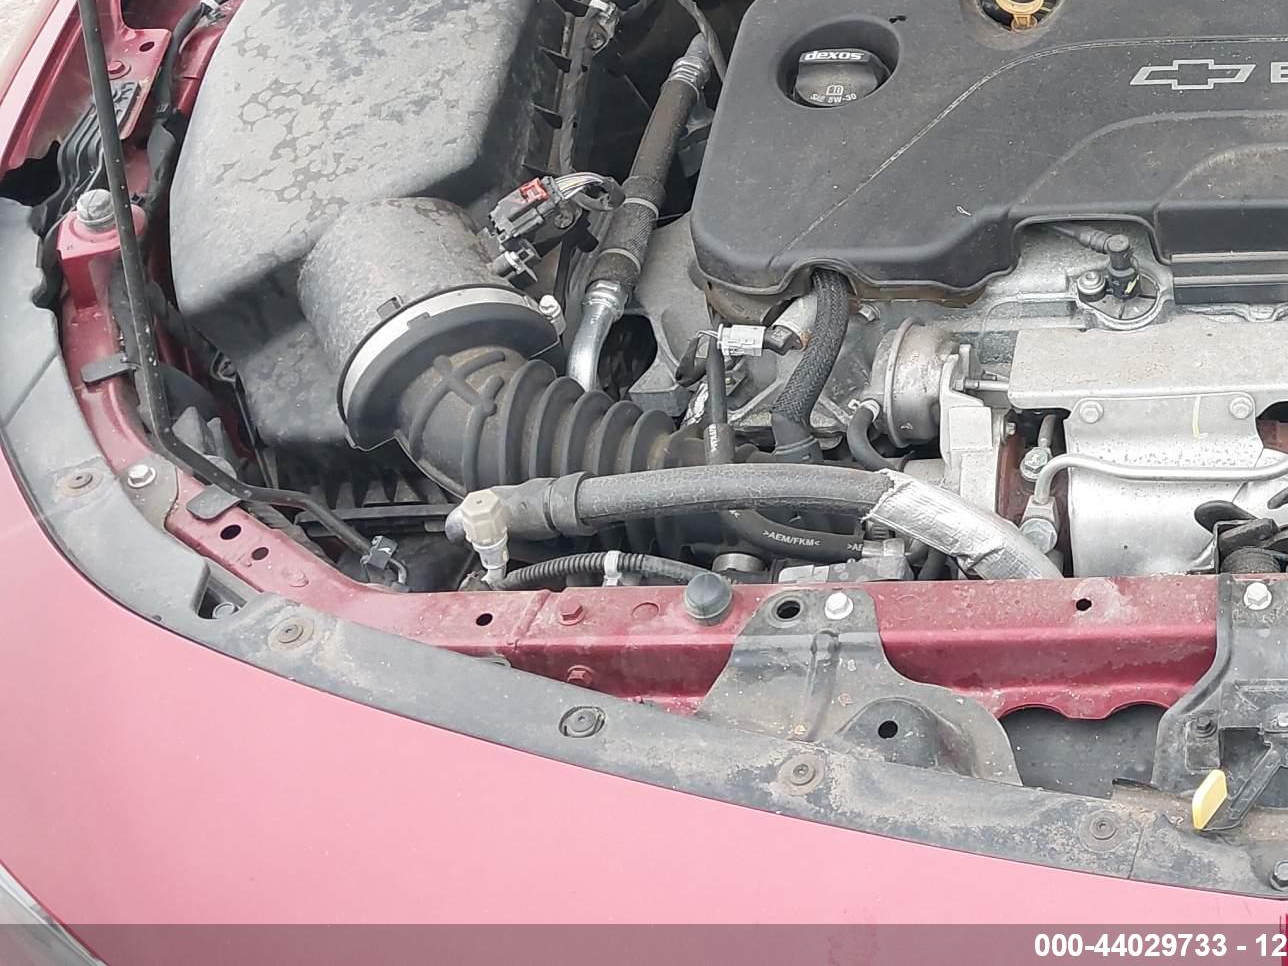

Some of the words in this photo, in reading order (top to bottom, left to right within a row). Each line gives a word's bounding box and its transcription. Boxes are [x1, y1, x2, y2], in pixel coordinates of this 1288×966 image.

[805, 51, 864, 61] dexos
[810, 93, 827, 103] SAE
[827, 93, 857, 104] 5W-30
[762, 529, 822, 547] >AEM/FKM<
